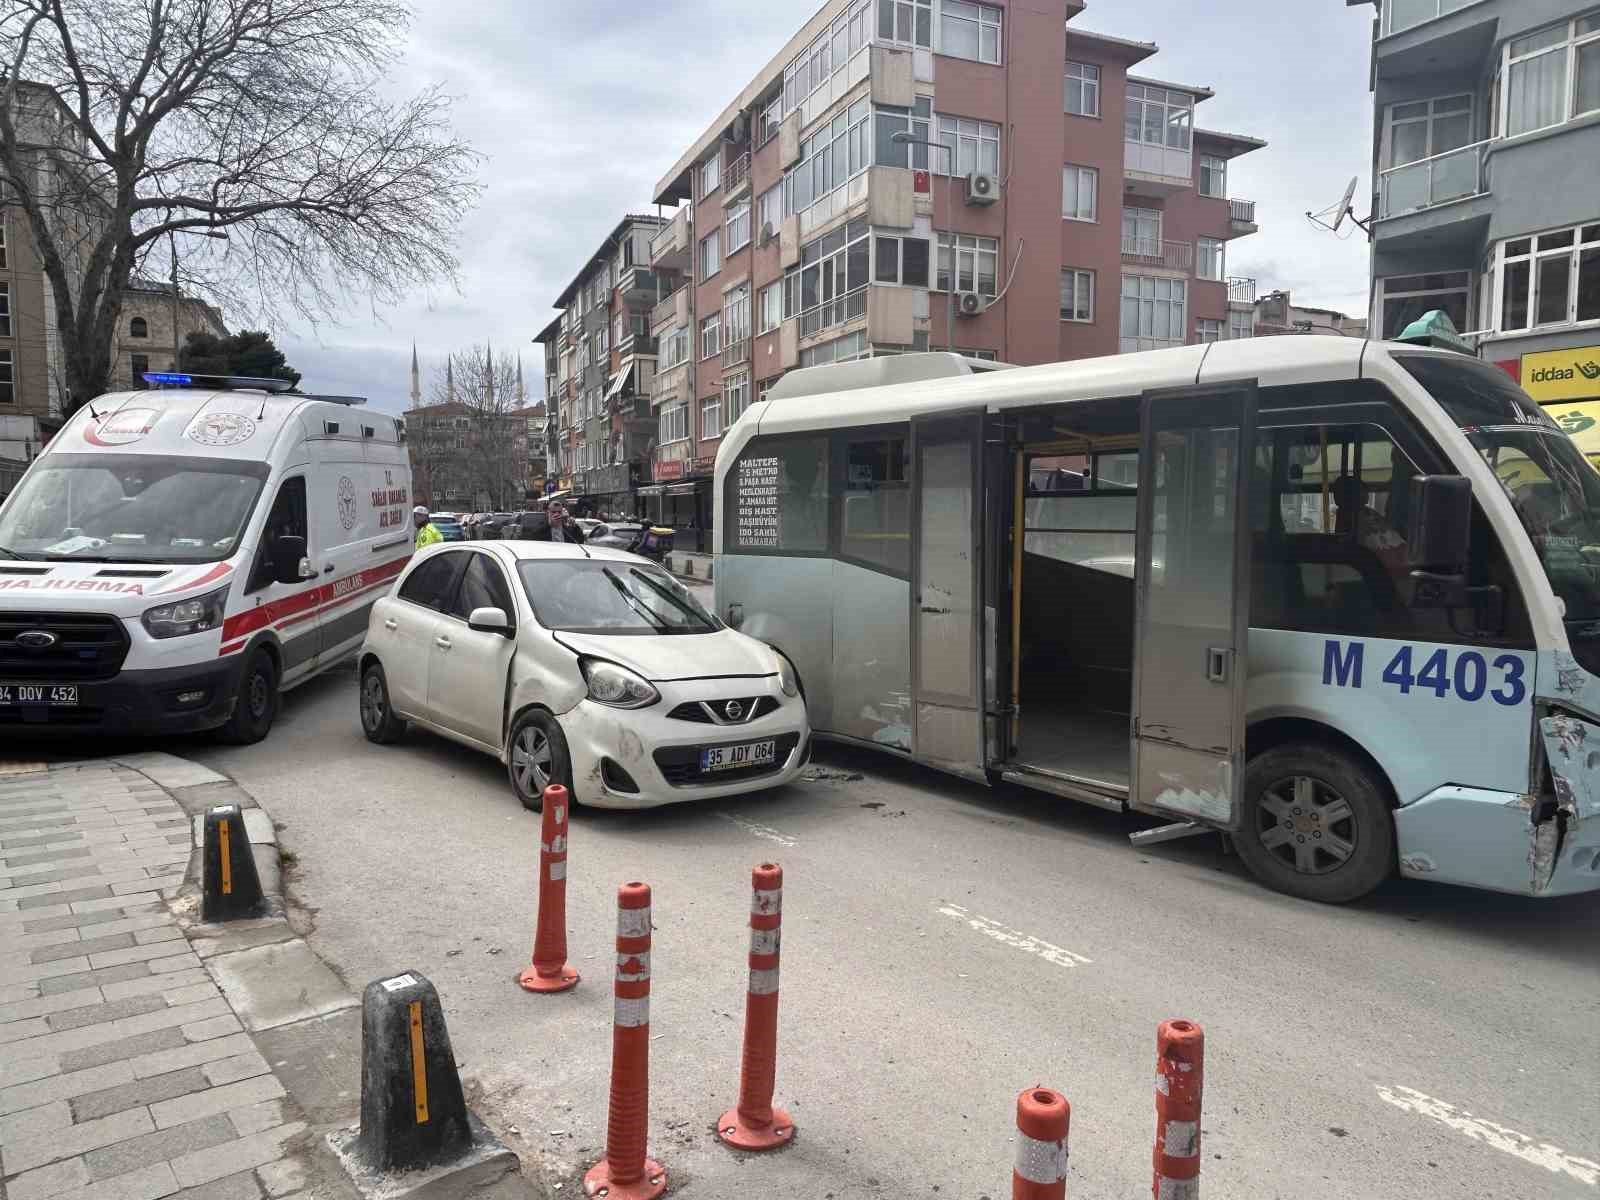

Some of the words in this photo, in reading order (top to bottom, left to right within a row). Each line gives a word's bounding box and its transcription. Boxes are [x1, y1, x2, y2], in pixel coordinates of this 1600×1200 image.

[1531, 367, 1574, 383] iddaa
[740, 457, 778, 468] MALTEPE
[1321, 639, 1365, 688] M
[1382, 645, 1526, 706] 4403
[51, 687, 76, 701] 452
[709, 749, 722, 765] 35
[730, 746, 750, 762] ADY
[754, 742, 774, 758] 064
